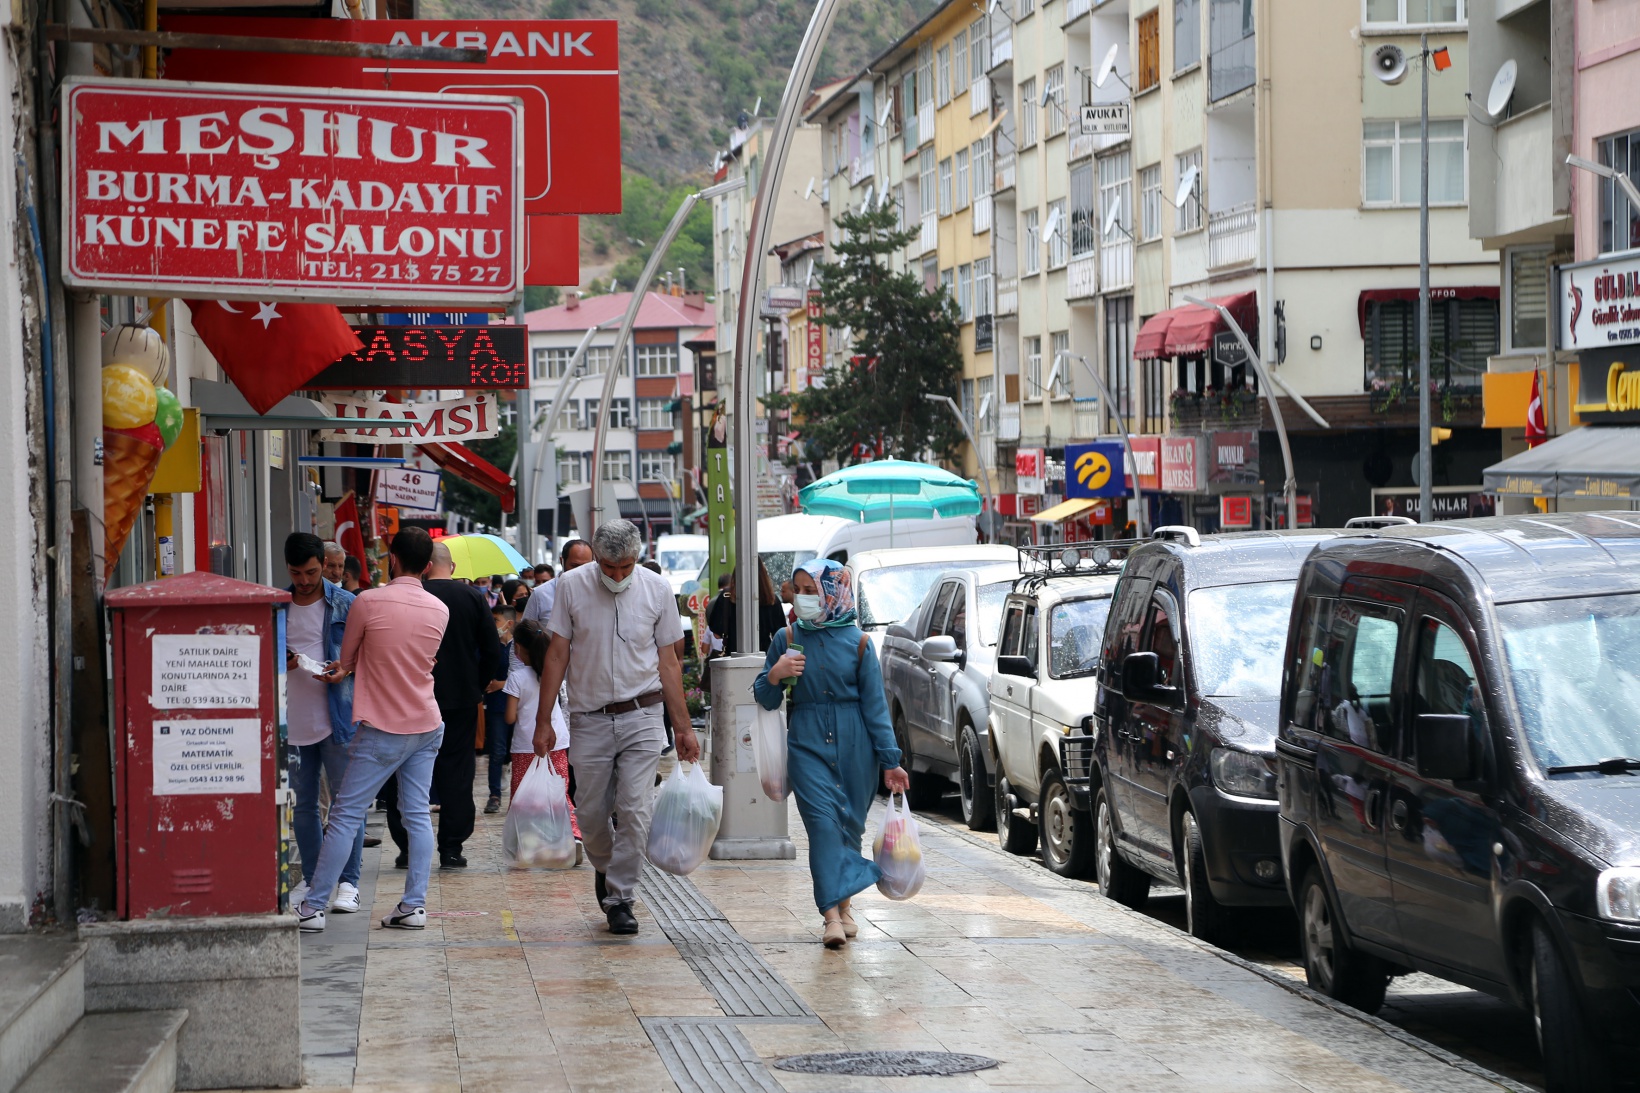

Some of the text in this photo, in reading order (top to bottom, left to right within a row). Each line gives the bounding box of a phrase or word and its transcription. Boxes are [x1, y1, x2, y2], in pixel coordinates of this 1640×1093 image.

[388, 31, 596, 57] AKBANK
[1086, 108, 1124, 120] AVUKAT
[96, 107, 496, 170] MEŞHUR
[86, 169, 502, 215] BURMA-KADAYIF
[83, 206, 504, 259] KÜNEFE SALONU
[305, 260, 501, 283] TEL: 213 75 27
[334, 395, 488, 437] HAMSİ
[402, 473, 421, 486] 46
[1406, 497, 1468, 512] DUANLAR
[179, 646, 239, 656] SATILIK DAİRE
[166, 658, 252, 668] YENİ MAHALLE TOKİ
[161, 672, 247, 680] KONUTLARINDA 2+1
[161, 683, 188, 692] DAİRE
[193, 696, 208, 704] 539
[210, 696, 225, 704] 431
[228, 696, 238, 704] 56
[240, 696, 251, 704] 70
[180, 726, 234, 736] YAZ DÖNEMİ
[182, 749, 234, 758] MATEMATİK
[170, 763, 189, 771] ÖZEL
[191, 762, 212, 771] DERSİ
[210, 775, 223, 783] 412
